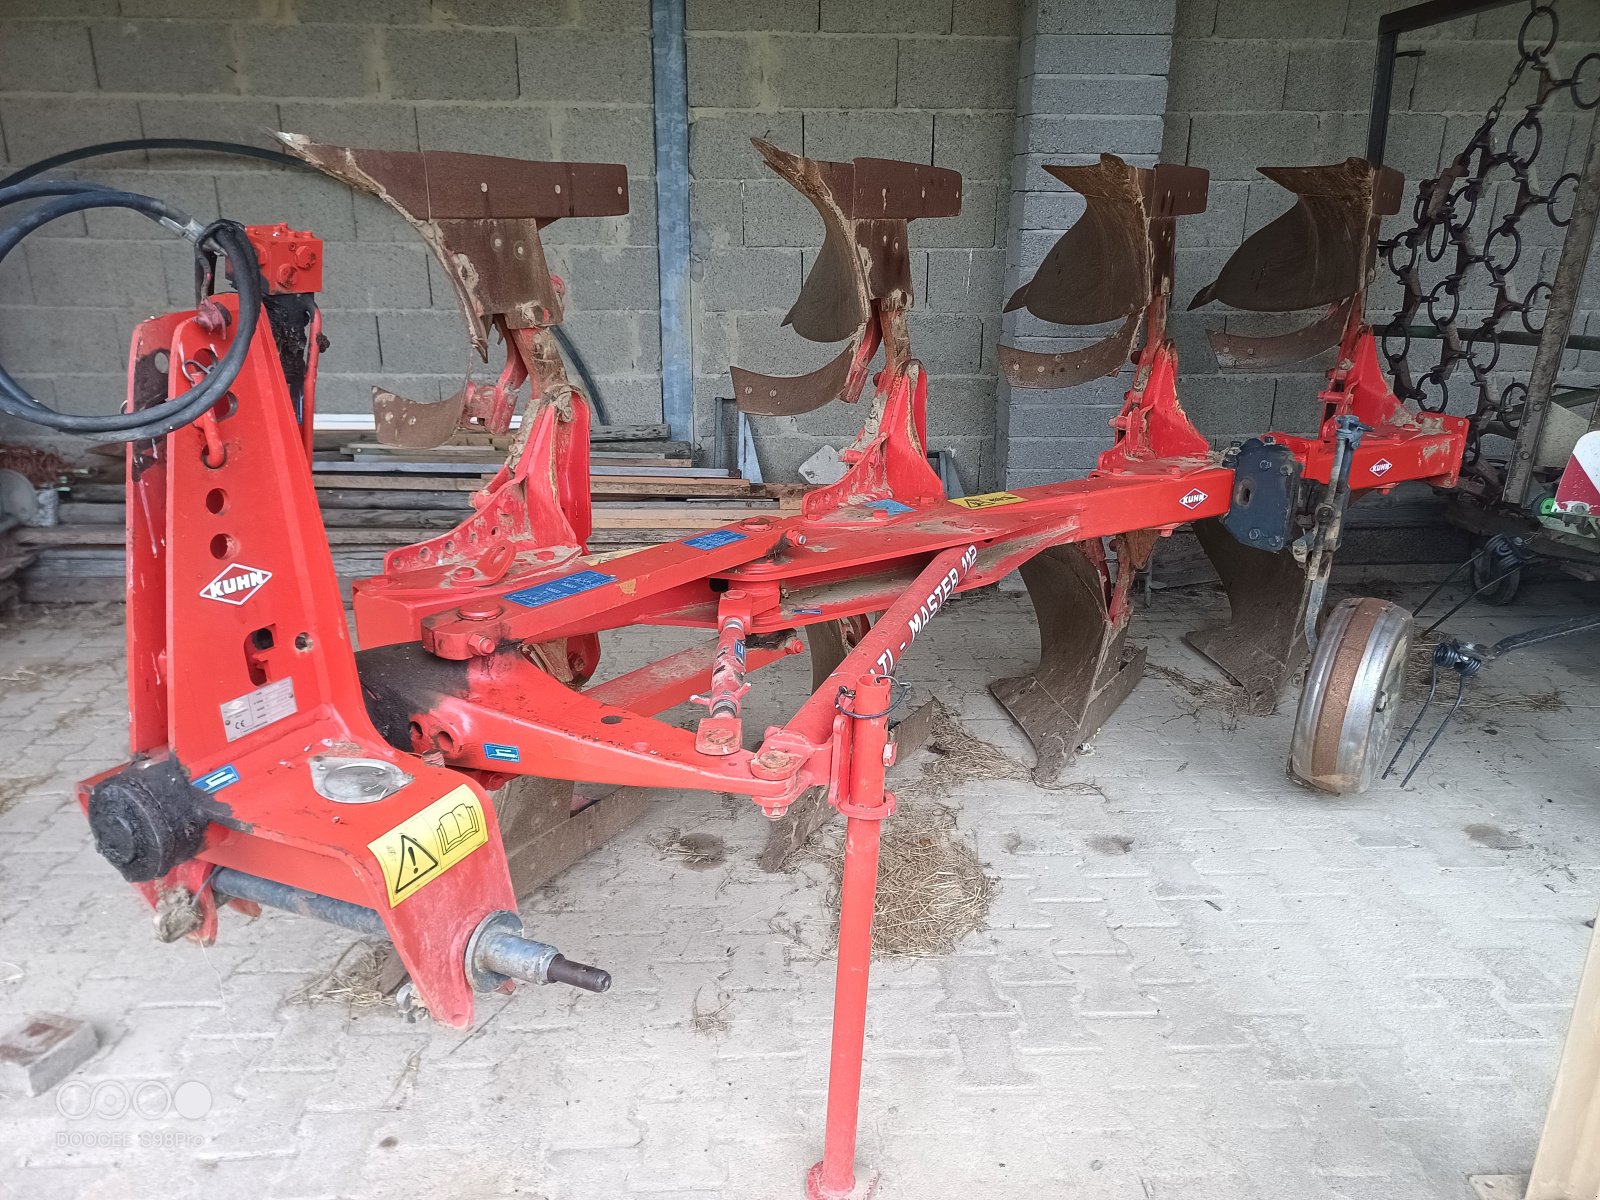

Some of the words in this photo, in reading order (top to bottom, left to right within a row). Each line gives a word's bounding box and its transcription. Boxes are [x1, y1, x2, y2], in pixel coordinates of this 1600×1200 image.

[1372, 463, 1390, 472] KUHN
[1183, 493, 1205, 504] KUHN
[209, 571, 264, 598] KUHN
[908, 567, 959, 641] MASTER
[961, 544, 977, 575] 112
